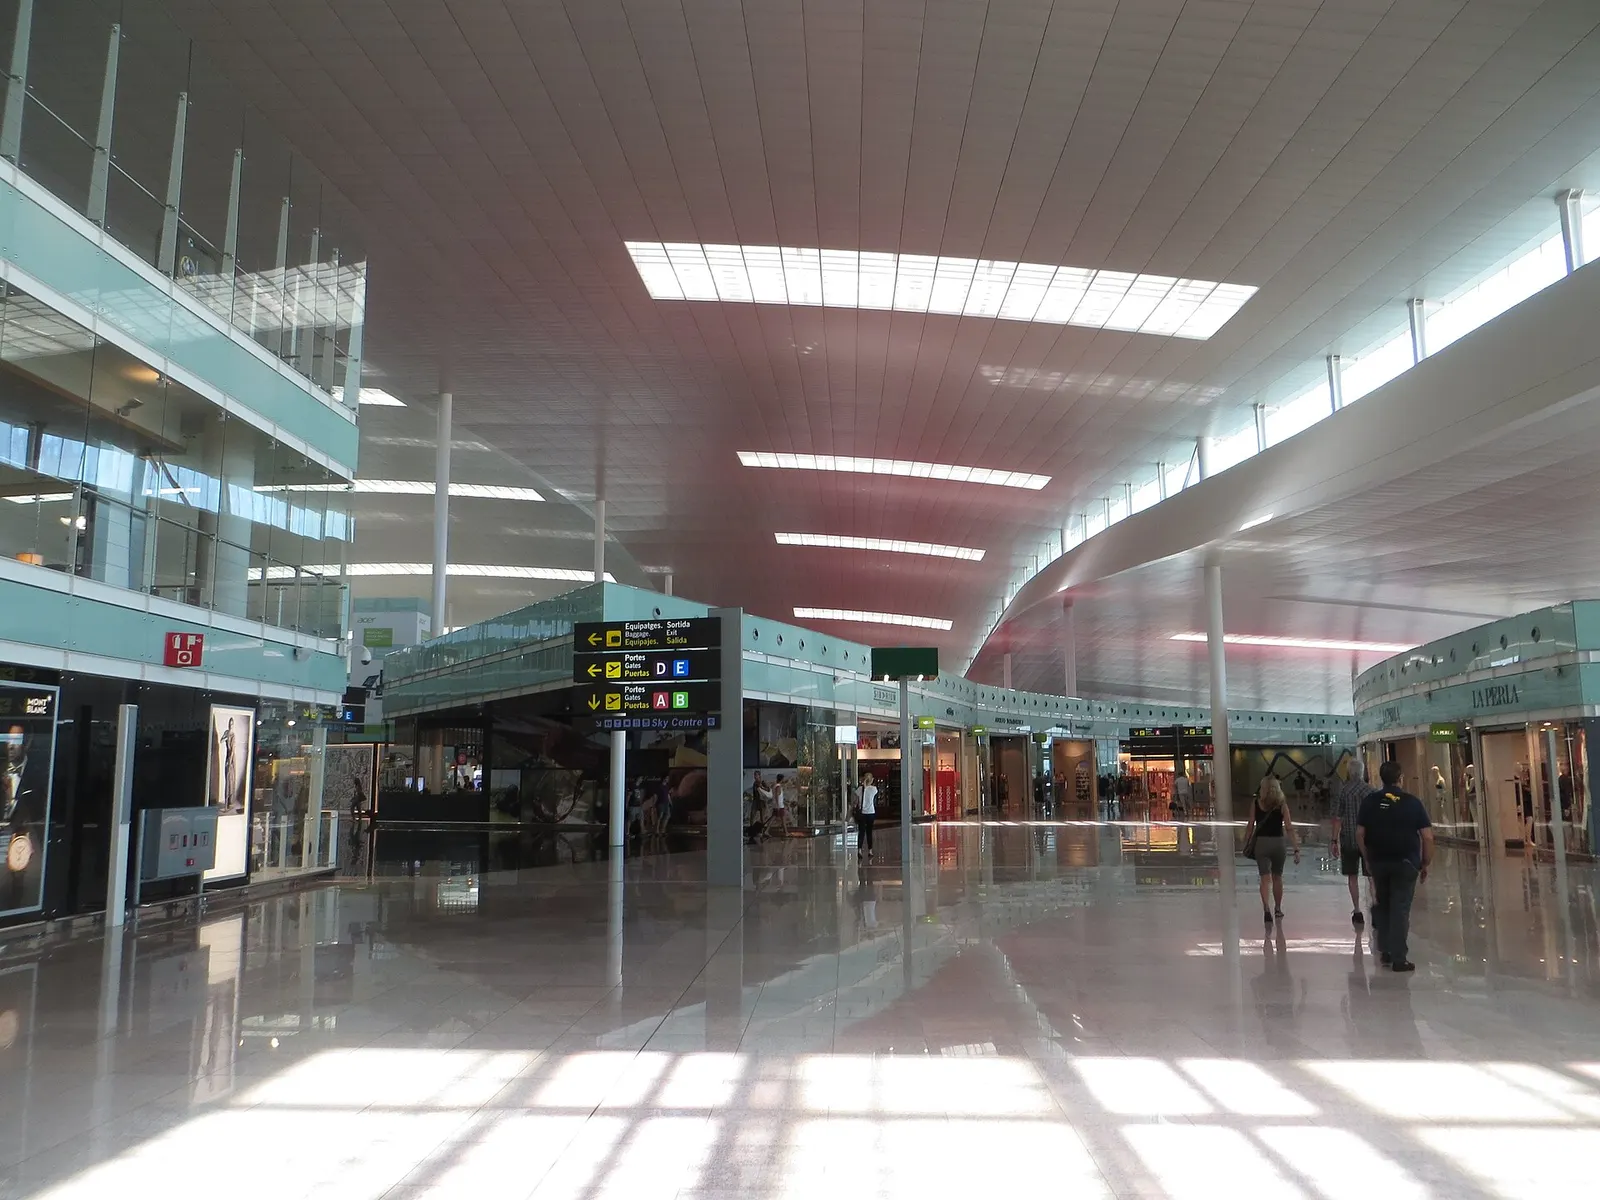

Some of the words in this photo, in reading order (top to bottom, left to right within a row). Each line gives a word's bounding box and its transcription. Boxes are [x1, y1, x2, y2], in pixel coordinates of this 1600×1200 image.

[625, 622, 663, 630] Equipatges.
[625, 638, 659, 646] Equipajes.
[656, 662, 666, 675] D
[676, 661, 685, 674] E
[656, 694, 666, 707] A
[676, 694, 685, 706] B
[1472, 689, 1484, 708] LA
[1485, 684, 1519, 707] PERLA
[27, 698, 47, 706] MONT
[26, 705, 47, 714] BLANC
[651, 718, 668, 729] Sky
[671, 718, 702, 727] Centre
